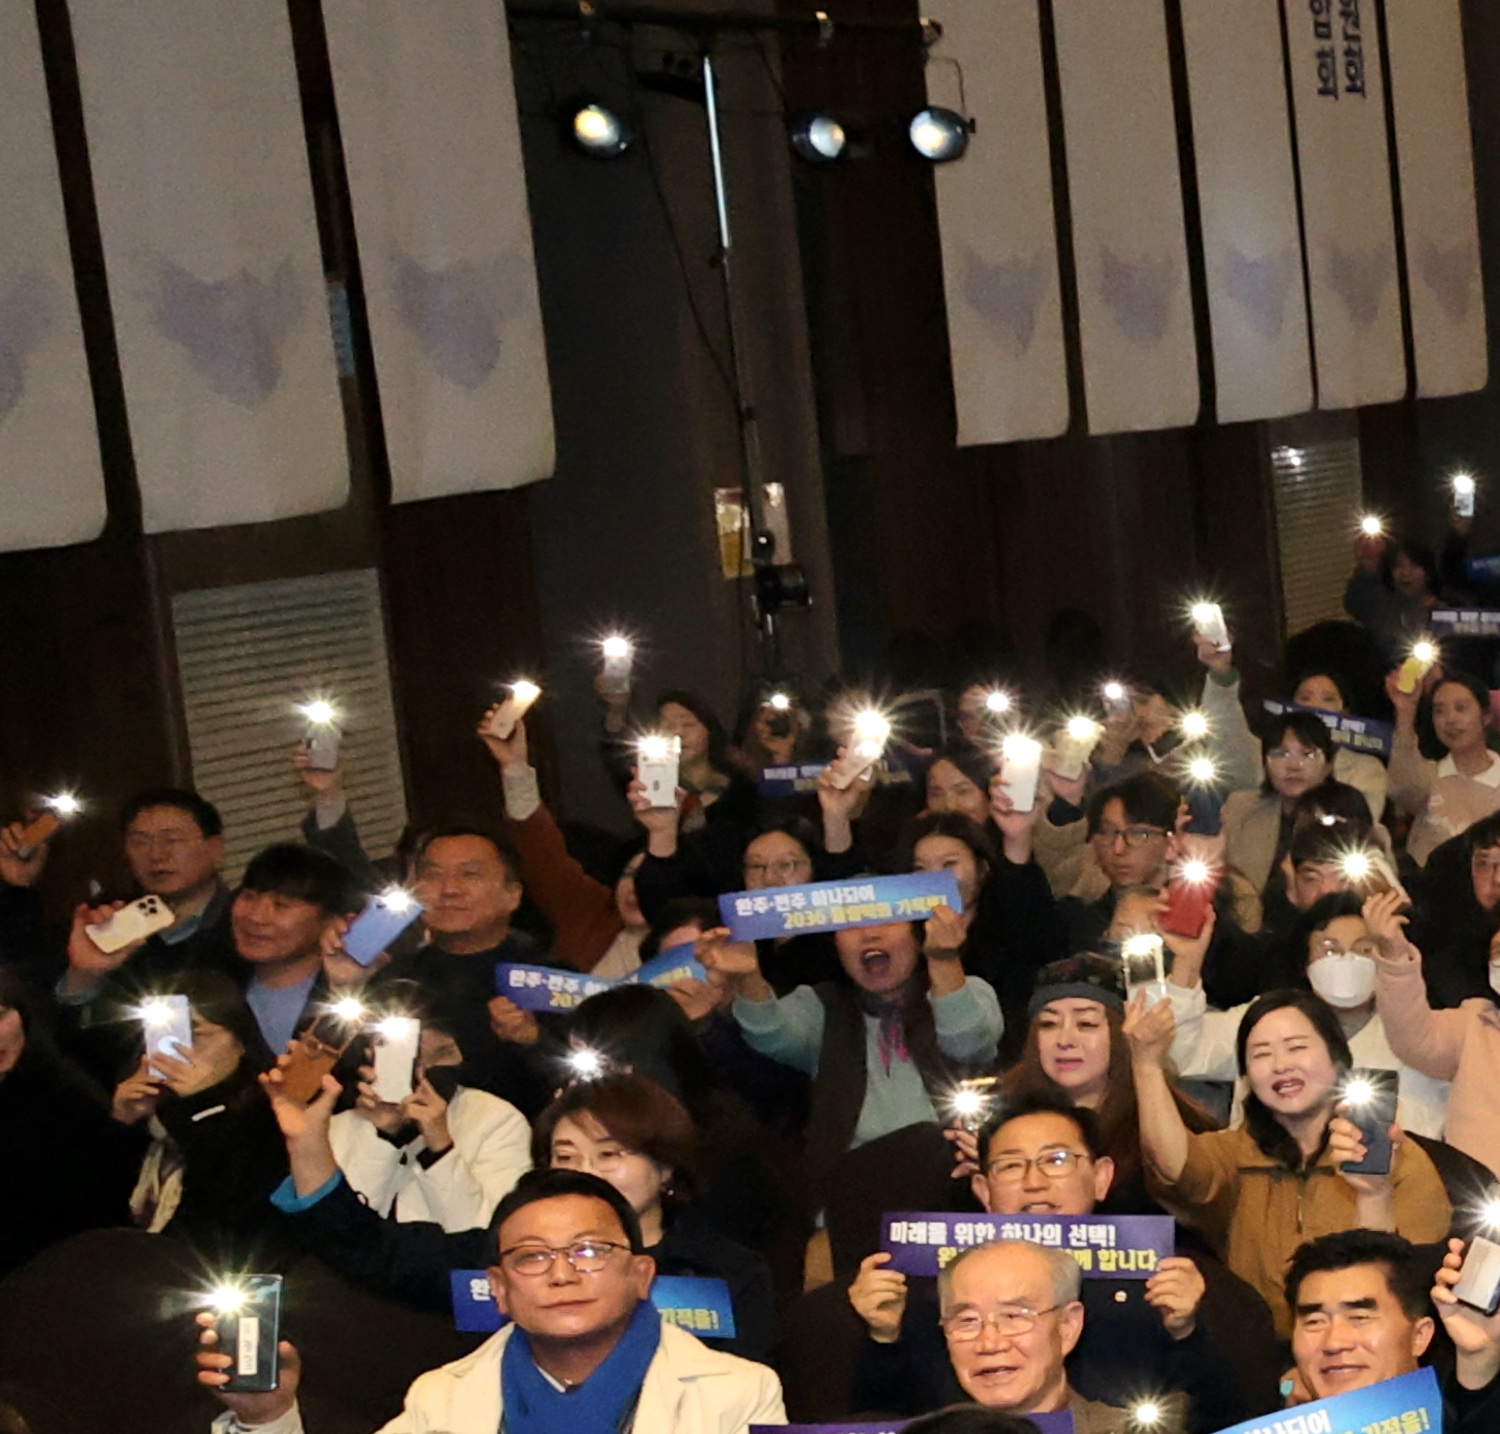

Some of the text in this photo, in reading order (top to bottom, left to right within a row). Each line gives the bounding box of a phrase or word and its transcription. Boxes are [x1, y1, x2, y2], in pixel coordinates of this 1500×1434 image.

[783, 905, 831, 928] 2036
[890, 1221, 1117, 1246] 미래를 위한 선택!
